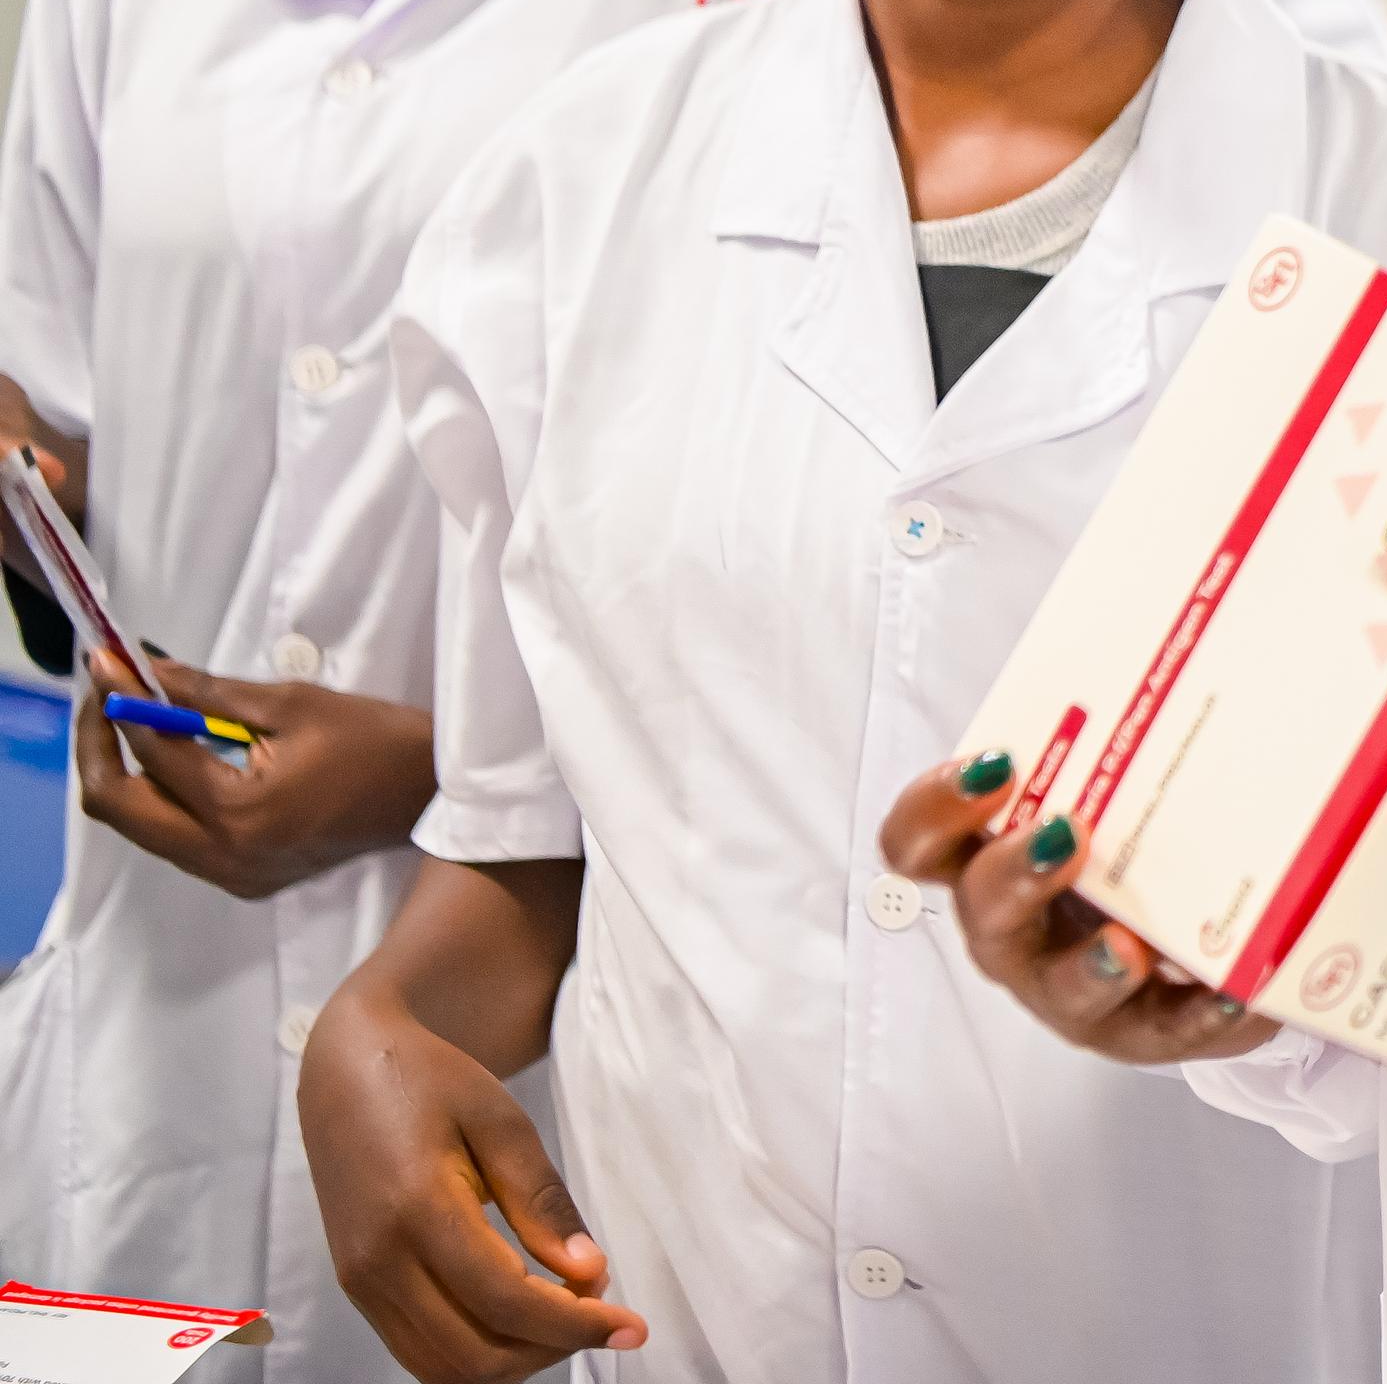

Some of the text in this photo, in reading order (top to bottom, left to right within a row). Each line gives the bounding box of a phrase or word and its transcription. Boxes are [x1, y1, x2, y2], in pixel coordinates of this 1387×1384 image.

[1147, 600, 1208, 693] Antigen
[1195, 552, 1239, 601] Test
[174, 1335, 198, 1346] 200
